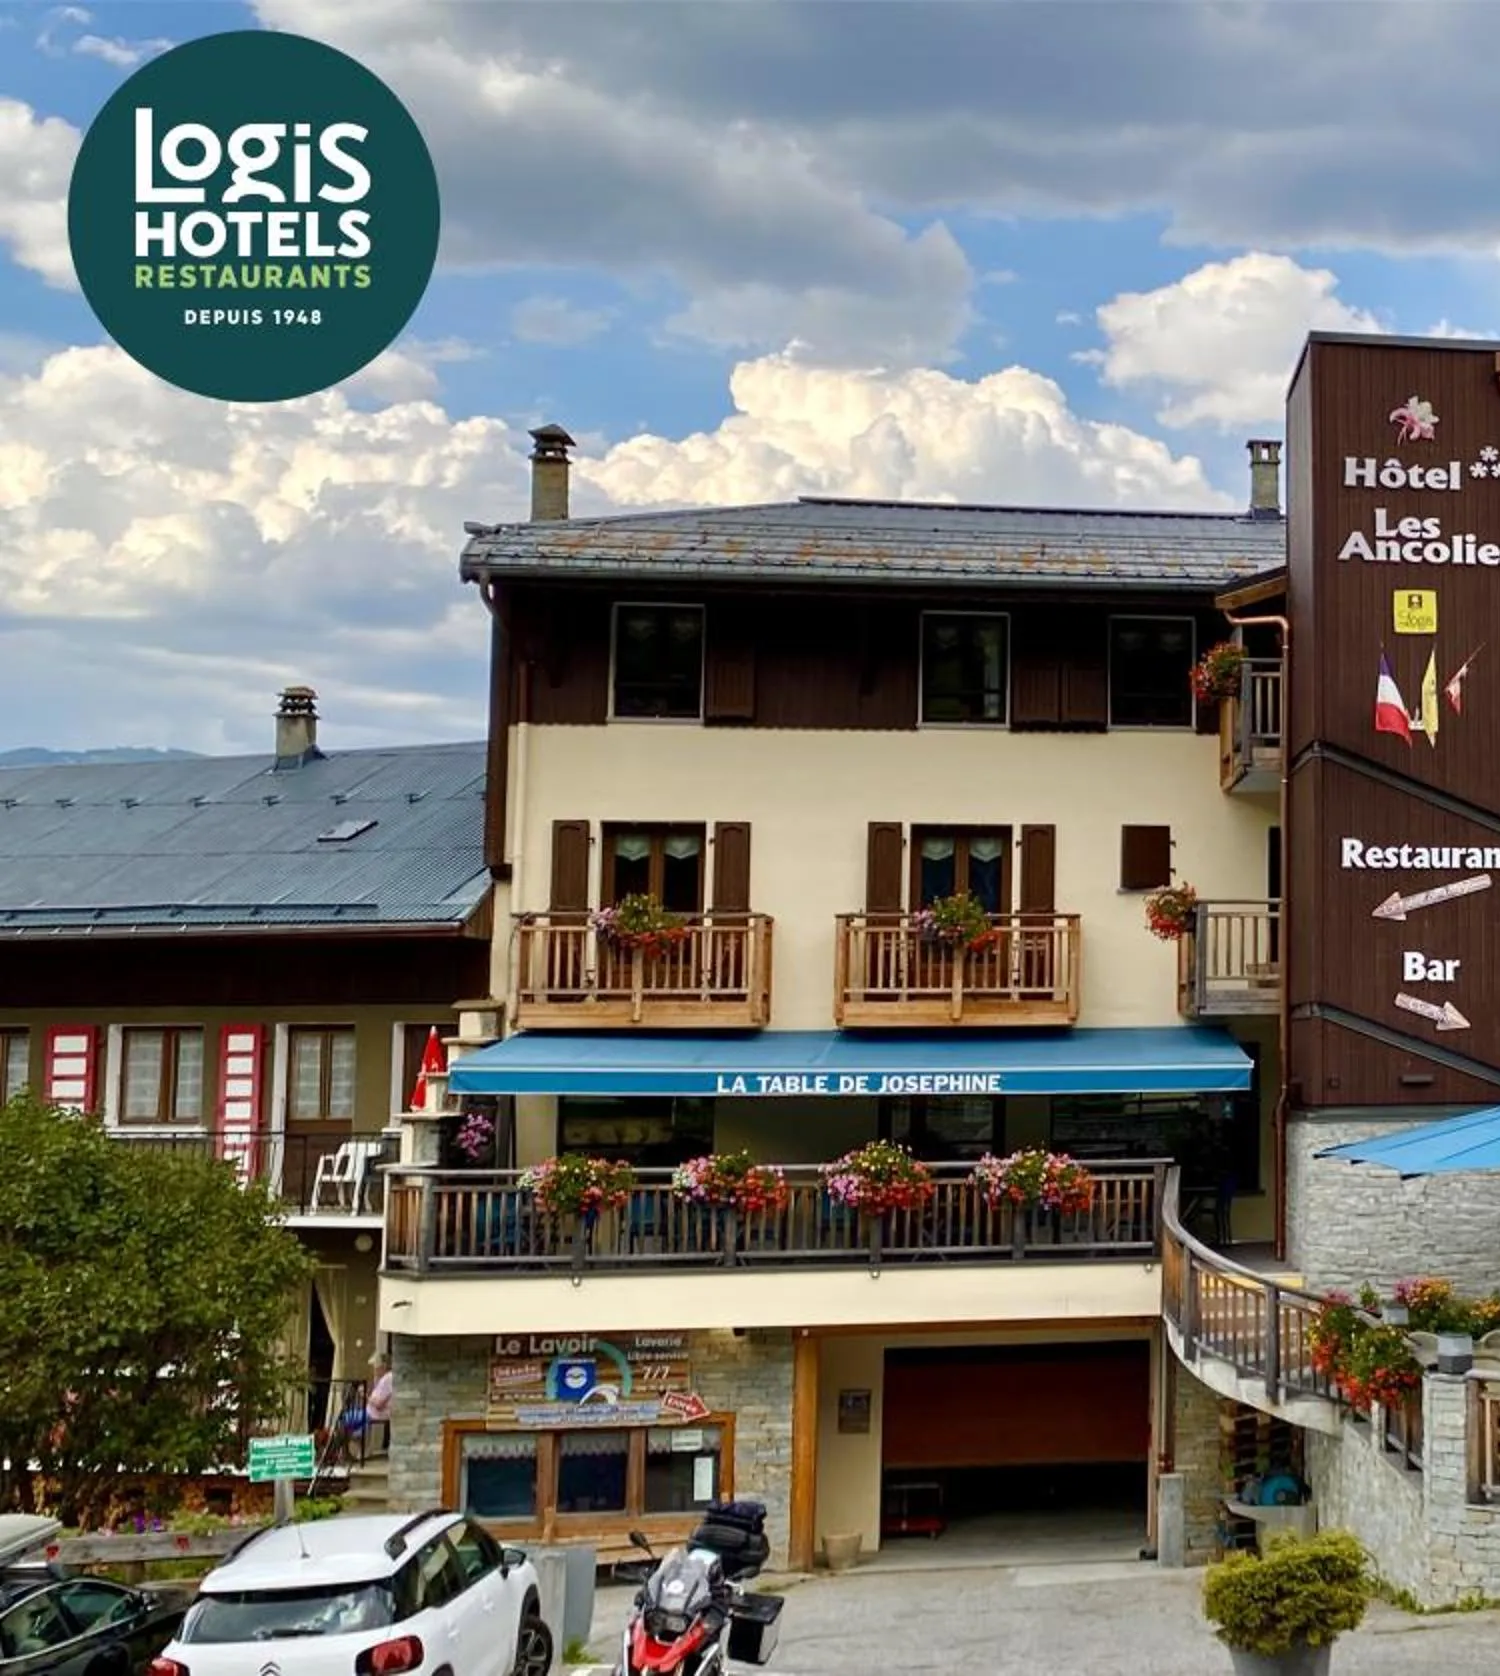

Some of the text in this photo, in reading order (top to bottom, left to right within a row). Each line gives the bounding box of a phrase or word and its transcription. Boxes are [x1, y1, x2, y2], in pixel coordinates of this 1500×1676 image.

[1343, 456, 1462, 491] Hôtel
[1374, 508, 1441, 539] Les
[1403, 951, 1461, 982] Bar
[716, 1073, 1002, 1094] LA TABLE DE JOSEPHINE
[495, 1333, 598, 1355] Le Lavoir
